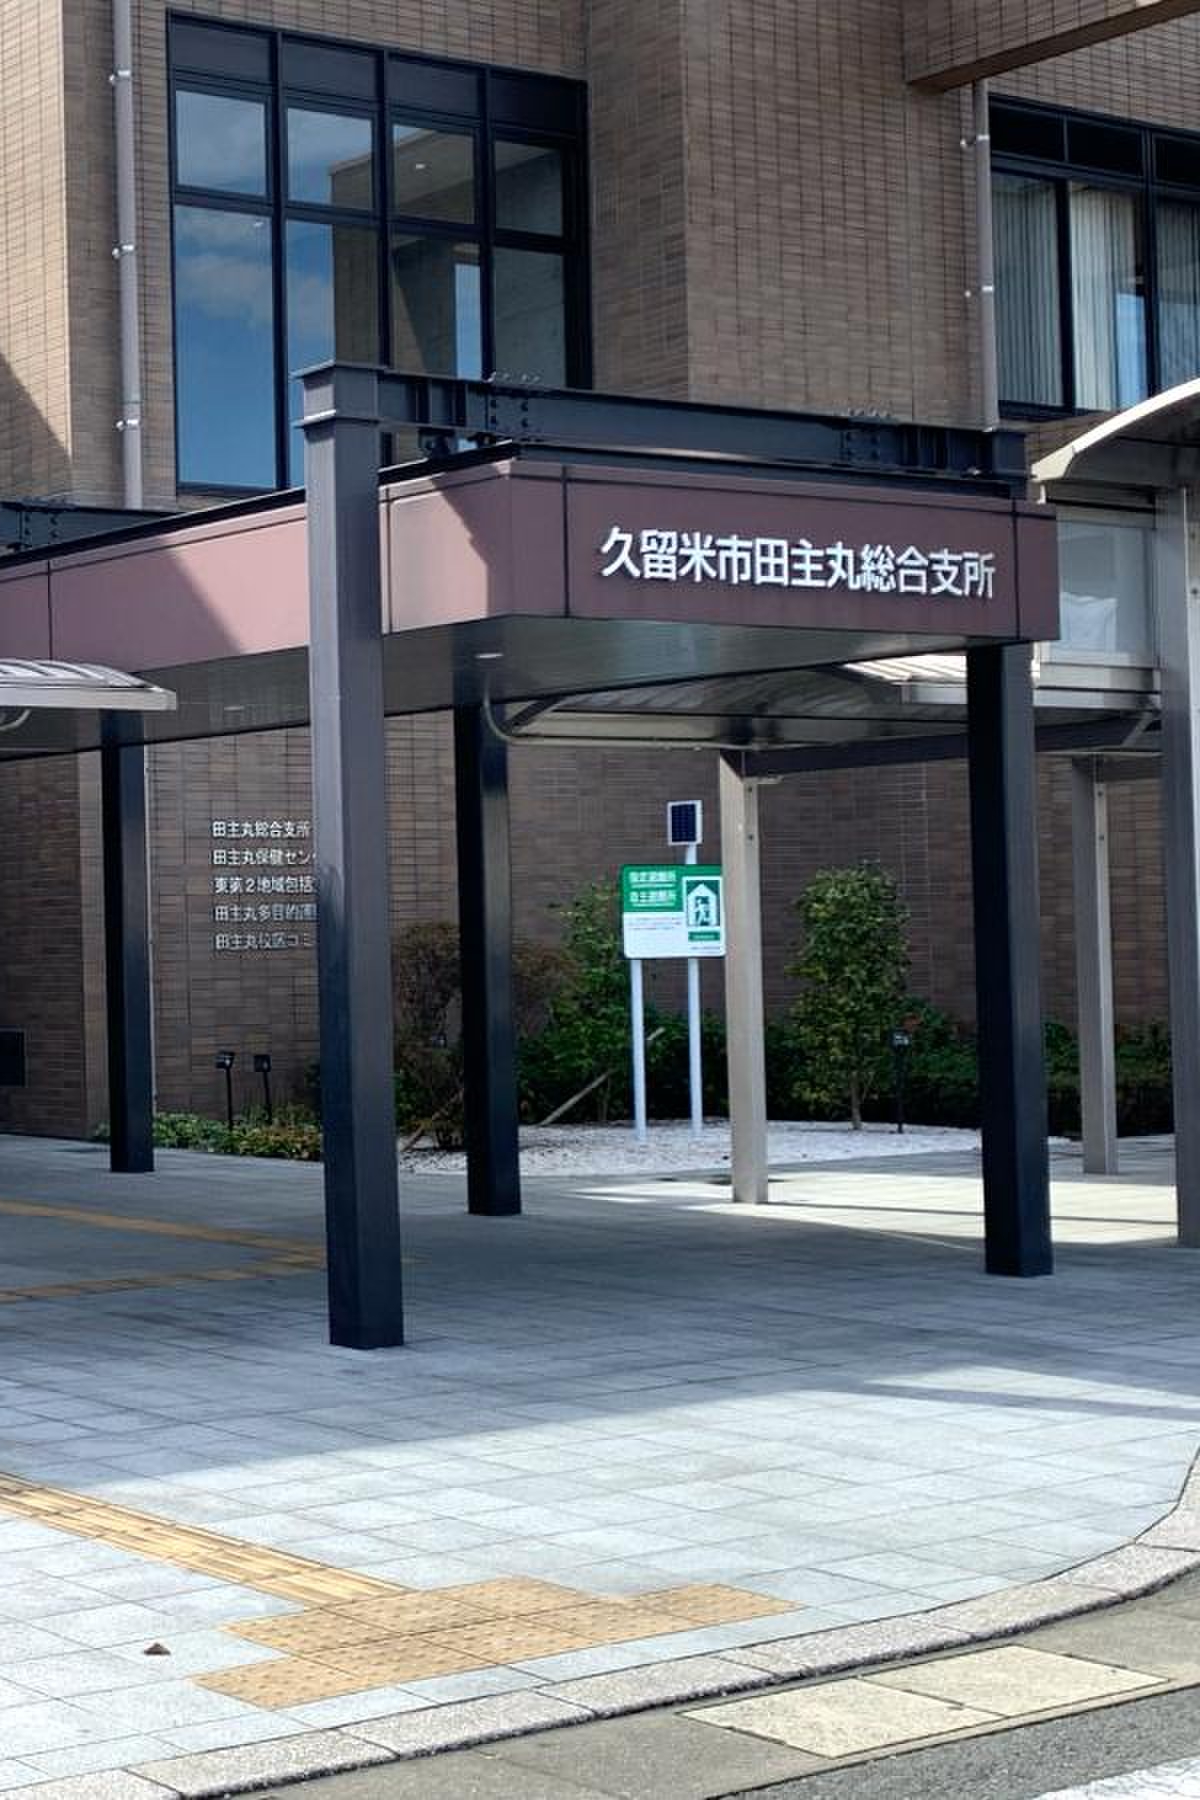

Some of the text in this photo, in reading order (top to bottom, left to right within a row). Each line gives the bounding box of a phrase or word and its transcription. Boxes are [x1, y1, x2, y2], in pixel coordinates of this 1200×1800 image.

[600, 526, 996, 599] 久留米市田主丸総合支所
[212, 820, 311, 838] 田主丸総合支所
[212, 848, 316, 865] 田主丸保健セン
